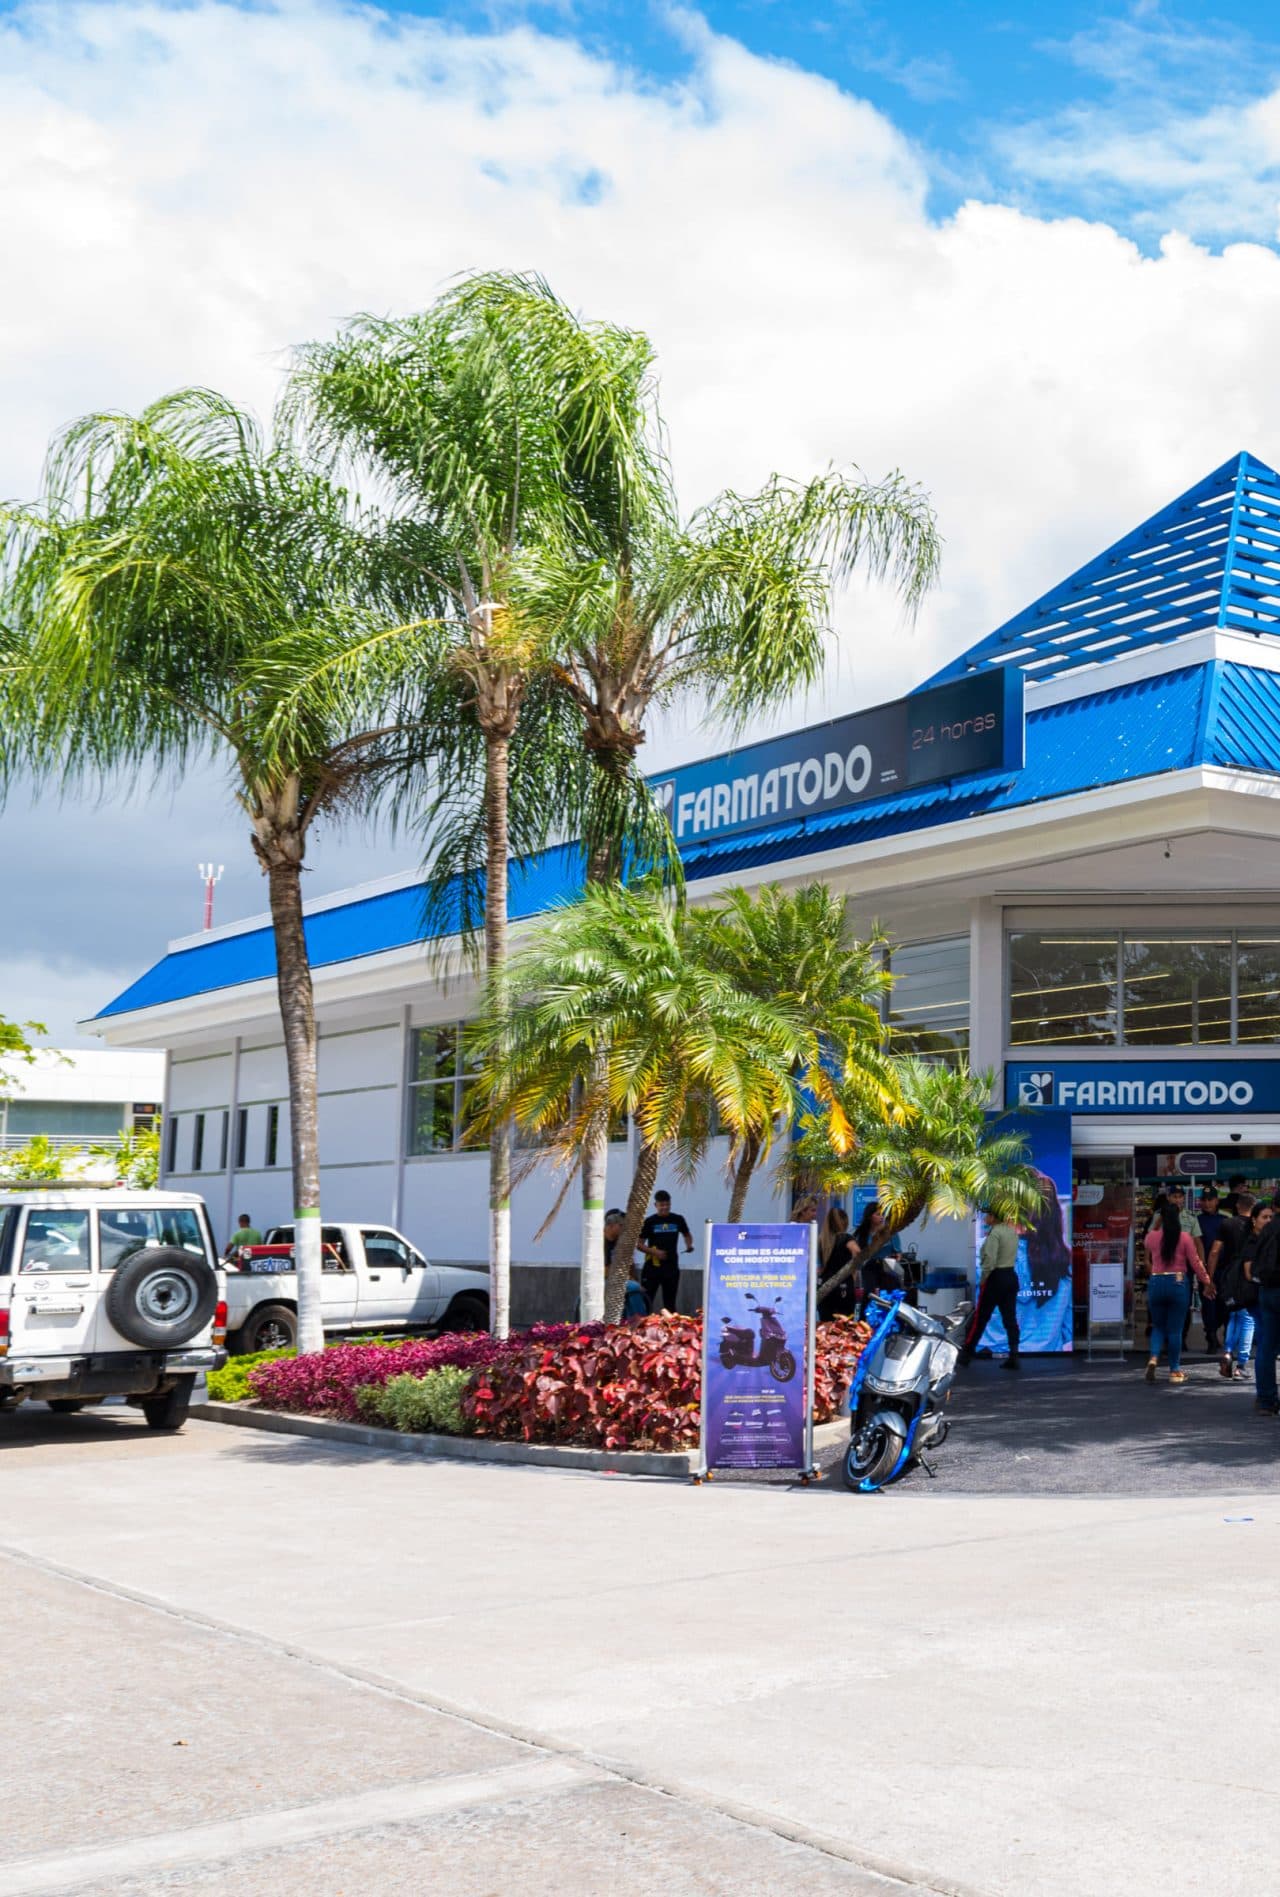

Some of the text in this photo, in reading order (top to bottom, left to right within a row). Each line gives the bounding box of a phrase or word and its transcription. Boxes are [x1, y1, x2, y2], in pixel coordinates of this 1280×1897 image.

[912, 713, 996, 750] 24 horas
[677, 744, 873, 837] FARMATODO
[1058, 1080, 1254, 1105] FARMATODO
